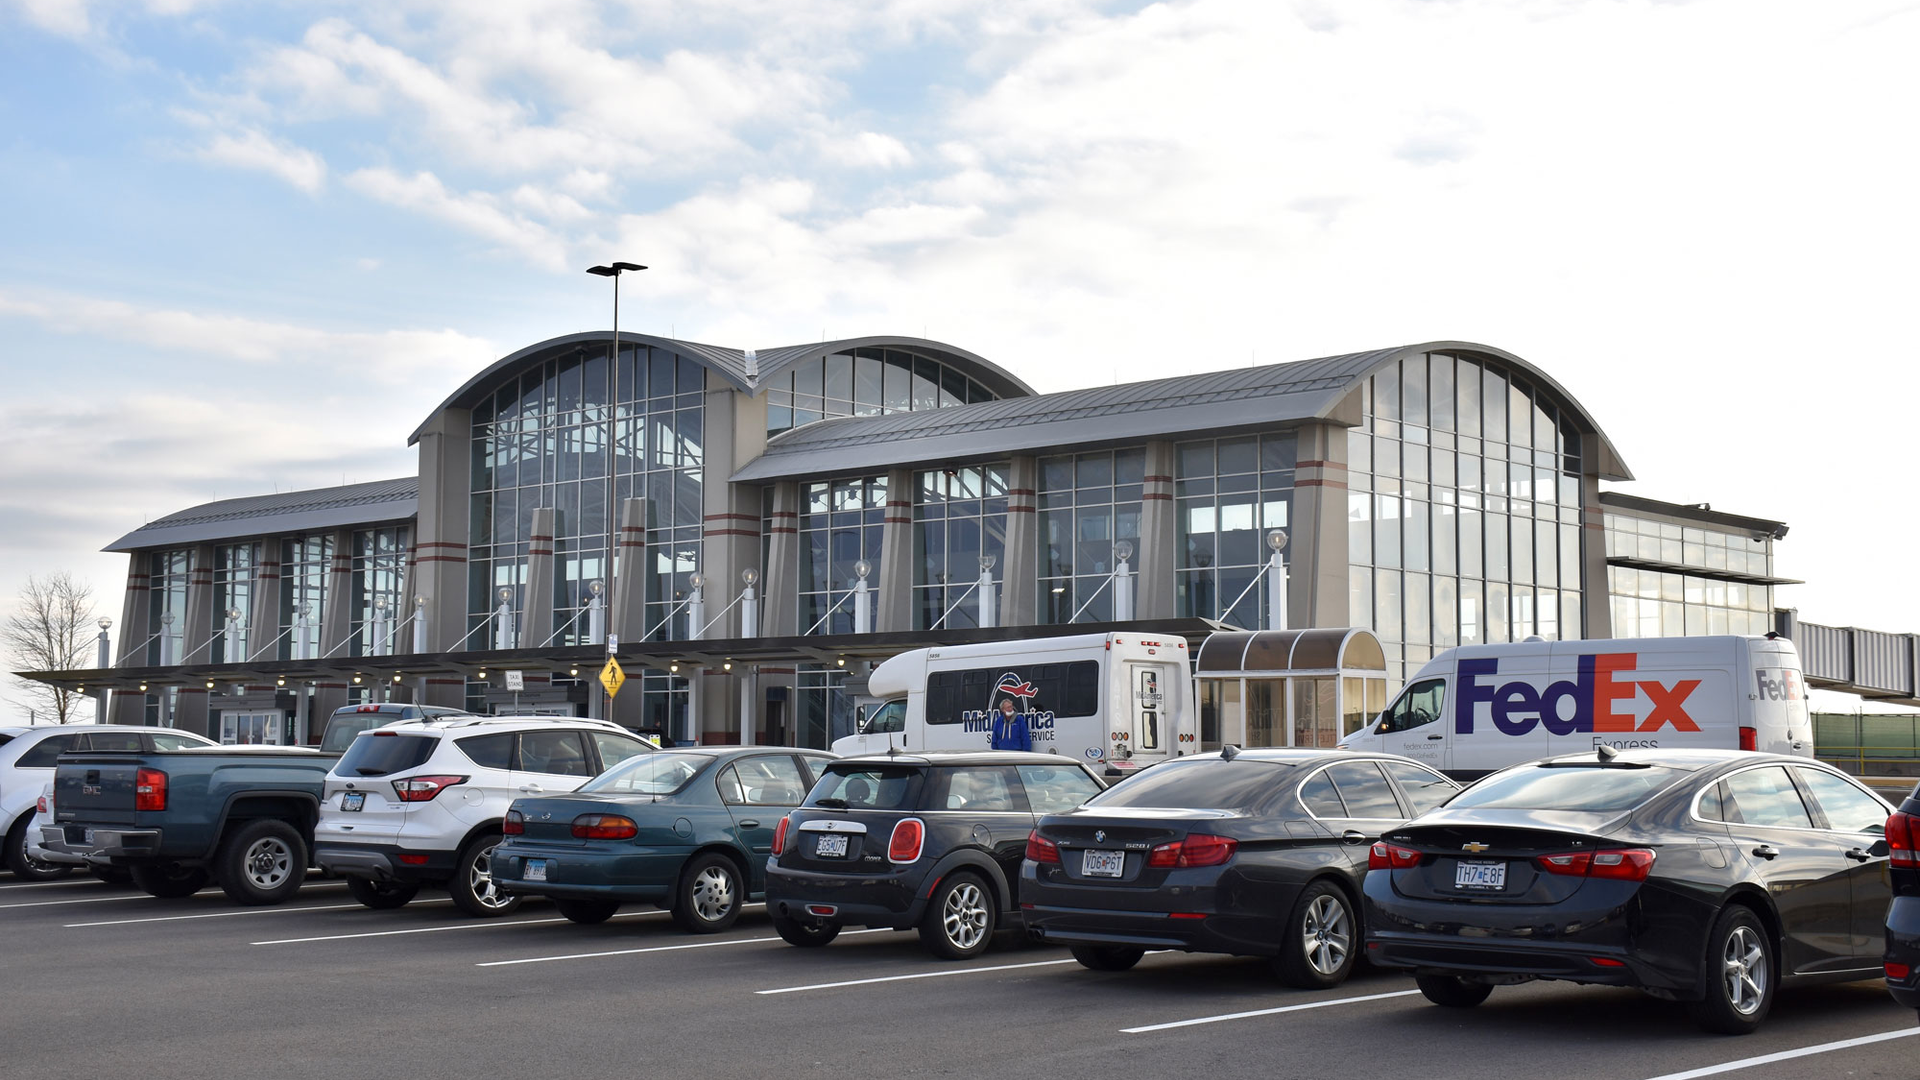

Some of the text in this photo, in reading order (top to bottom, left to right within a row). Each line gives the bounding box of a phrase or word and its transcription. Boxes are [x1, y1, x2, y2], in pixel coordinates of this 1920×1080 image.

[1455, 652, 1703, 736] FedEx
[1403, 742, 1438, 751] fedex.com
[83, 786, 101, 795] GMC
